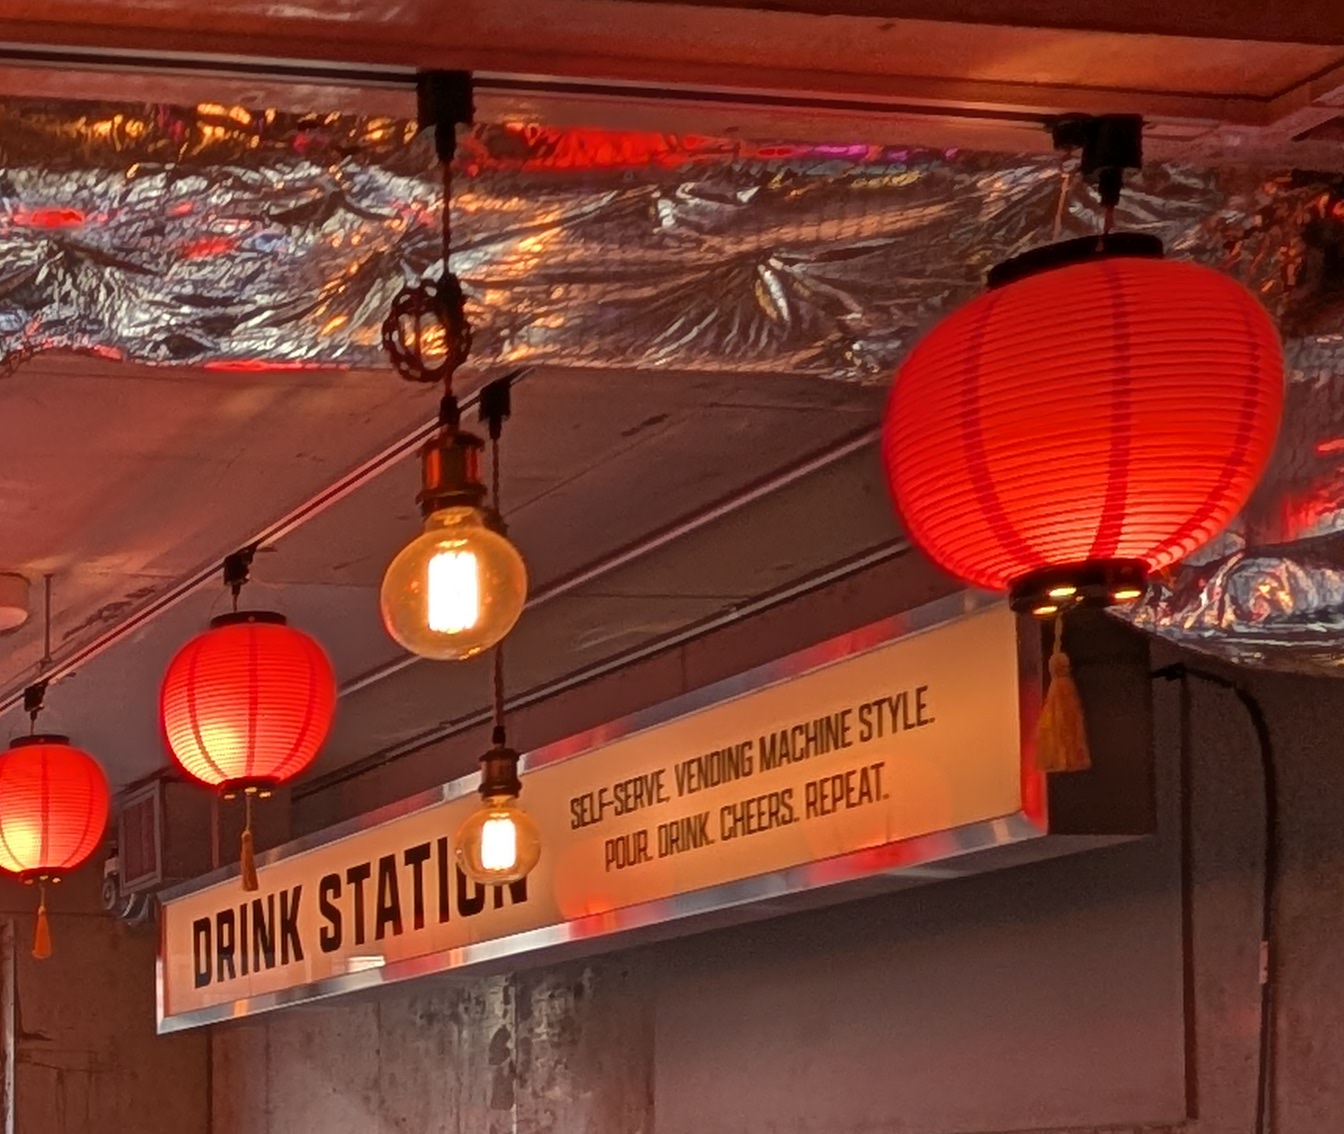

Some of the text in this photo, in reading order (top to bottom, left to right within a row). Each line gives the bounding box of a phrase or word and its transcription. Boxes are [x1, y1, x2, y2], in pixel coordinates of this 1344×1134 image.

[674, 740, 752, 797] VENDING
[759, 709, 853, 773] MACHINE
[858, 685, 935, 743] STYLE.
[605, 762, 890, 872] POUR. DRINK. CHEERS. REPEAT.
[193, 884, 304, 989] DRINK
